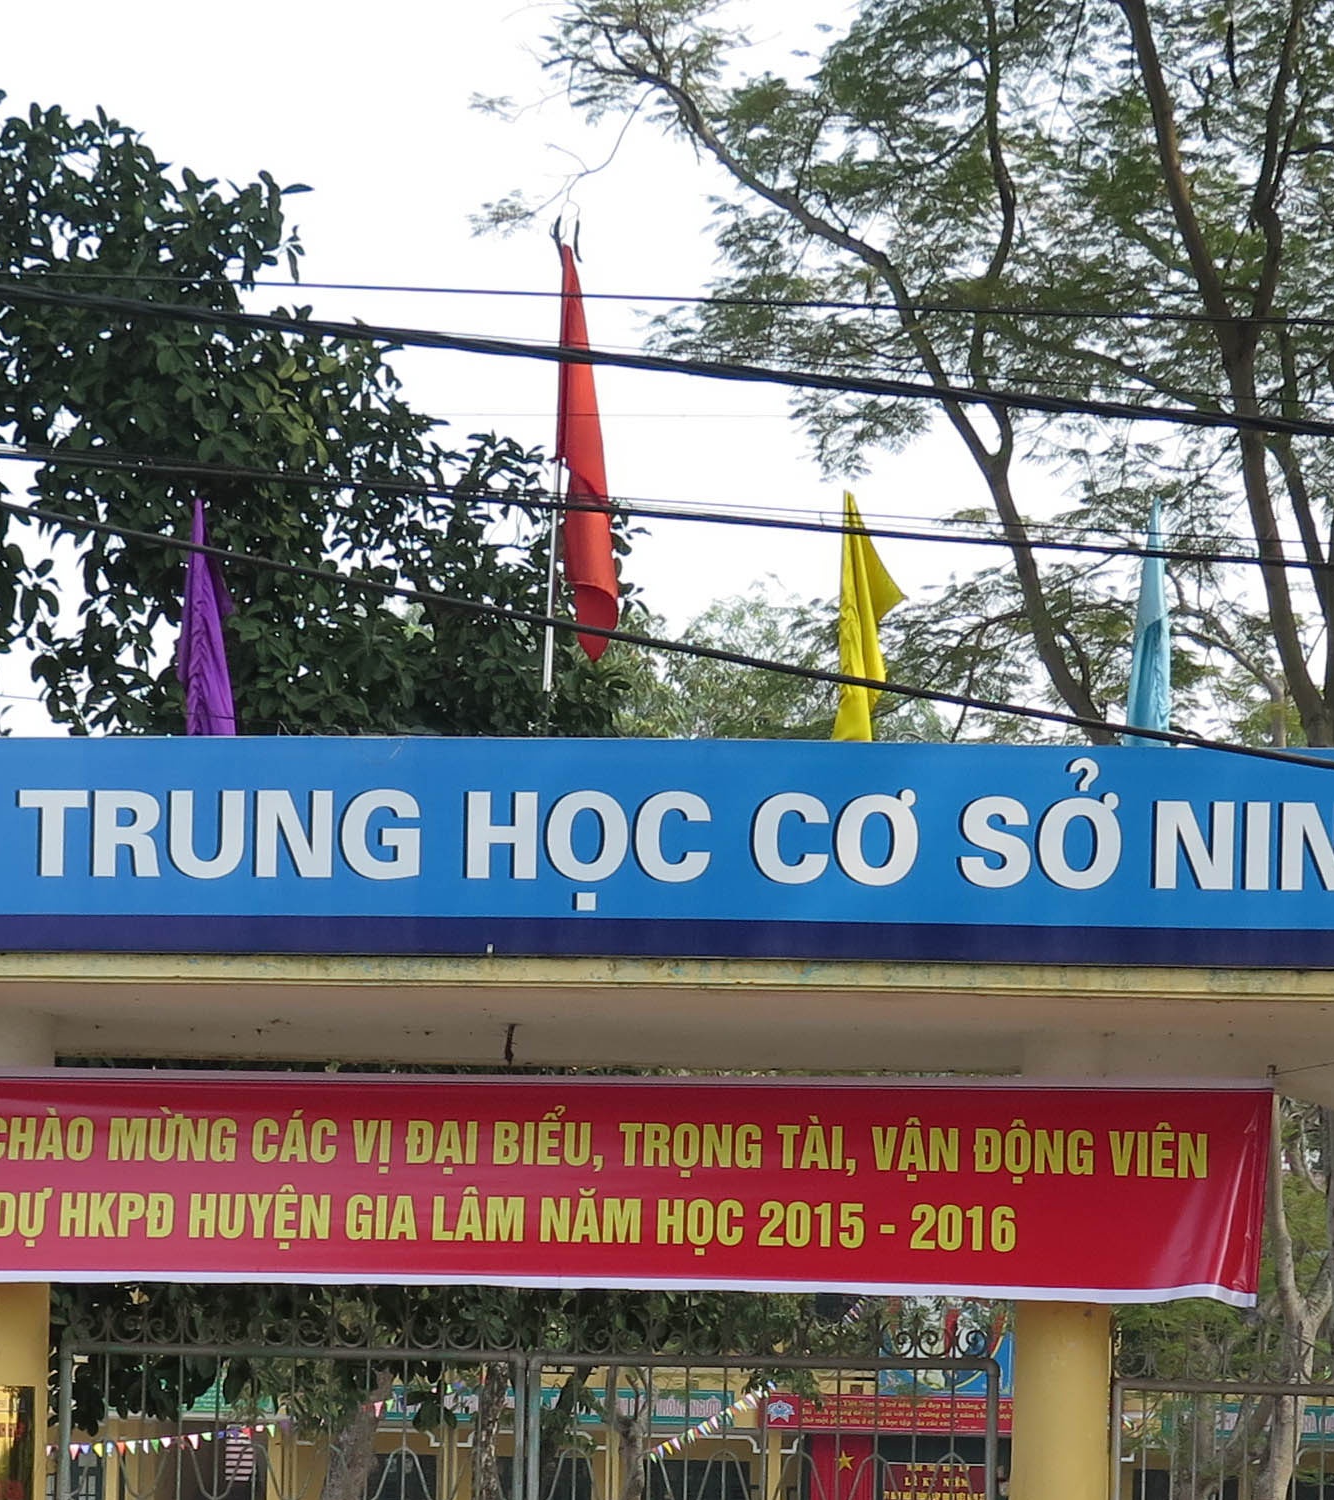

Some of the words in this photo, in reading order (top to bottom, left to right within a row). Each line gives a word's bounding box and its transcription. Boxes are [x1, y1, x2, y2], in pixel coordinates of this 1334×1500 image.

[19, 789, 421, 880] TRUNG
[465, 789, 712, 912] HỌC
[752, 788, 919, 886] CƠ
[959, 757, 1121, 890] SỞ
[108, 1106, 238, 1163] MỪNG
[251, 1108, 338, 1164] CÁC
[353, 1120, 392, 1174] VỊ
[406, 1120, 478, 1176] ĐẠI
[493, 1104, 604, 1172] BIỂU,
[619, 1122, 763, 1180] TRỌNG
[777, 1115, 857, 1176] TÀI,
[871, 1117, 960, 1182] VẬN
[974, 1118, 1094, 1184] ĐỘNG
[1109, 1122, 1208, 1179] VIÊN
[64, 1192, 174, 1239] HKPĐ
[188, 1185, 331, 1250] HUYỆN
[345, 1195, 418, 1241] GIA
[431, 1187, 525, 1243] LÂM
[539, 1188, 642, 1245] NĂM
[656, 1198, 745, 1256] HỌC
[757, 1201, 866, 1250] 2015
[879, 1224, 897, 1235] -
[910, 1203, 1018, 1253] 2016
